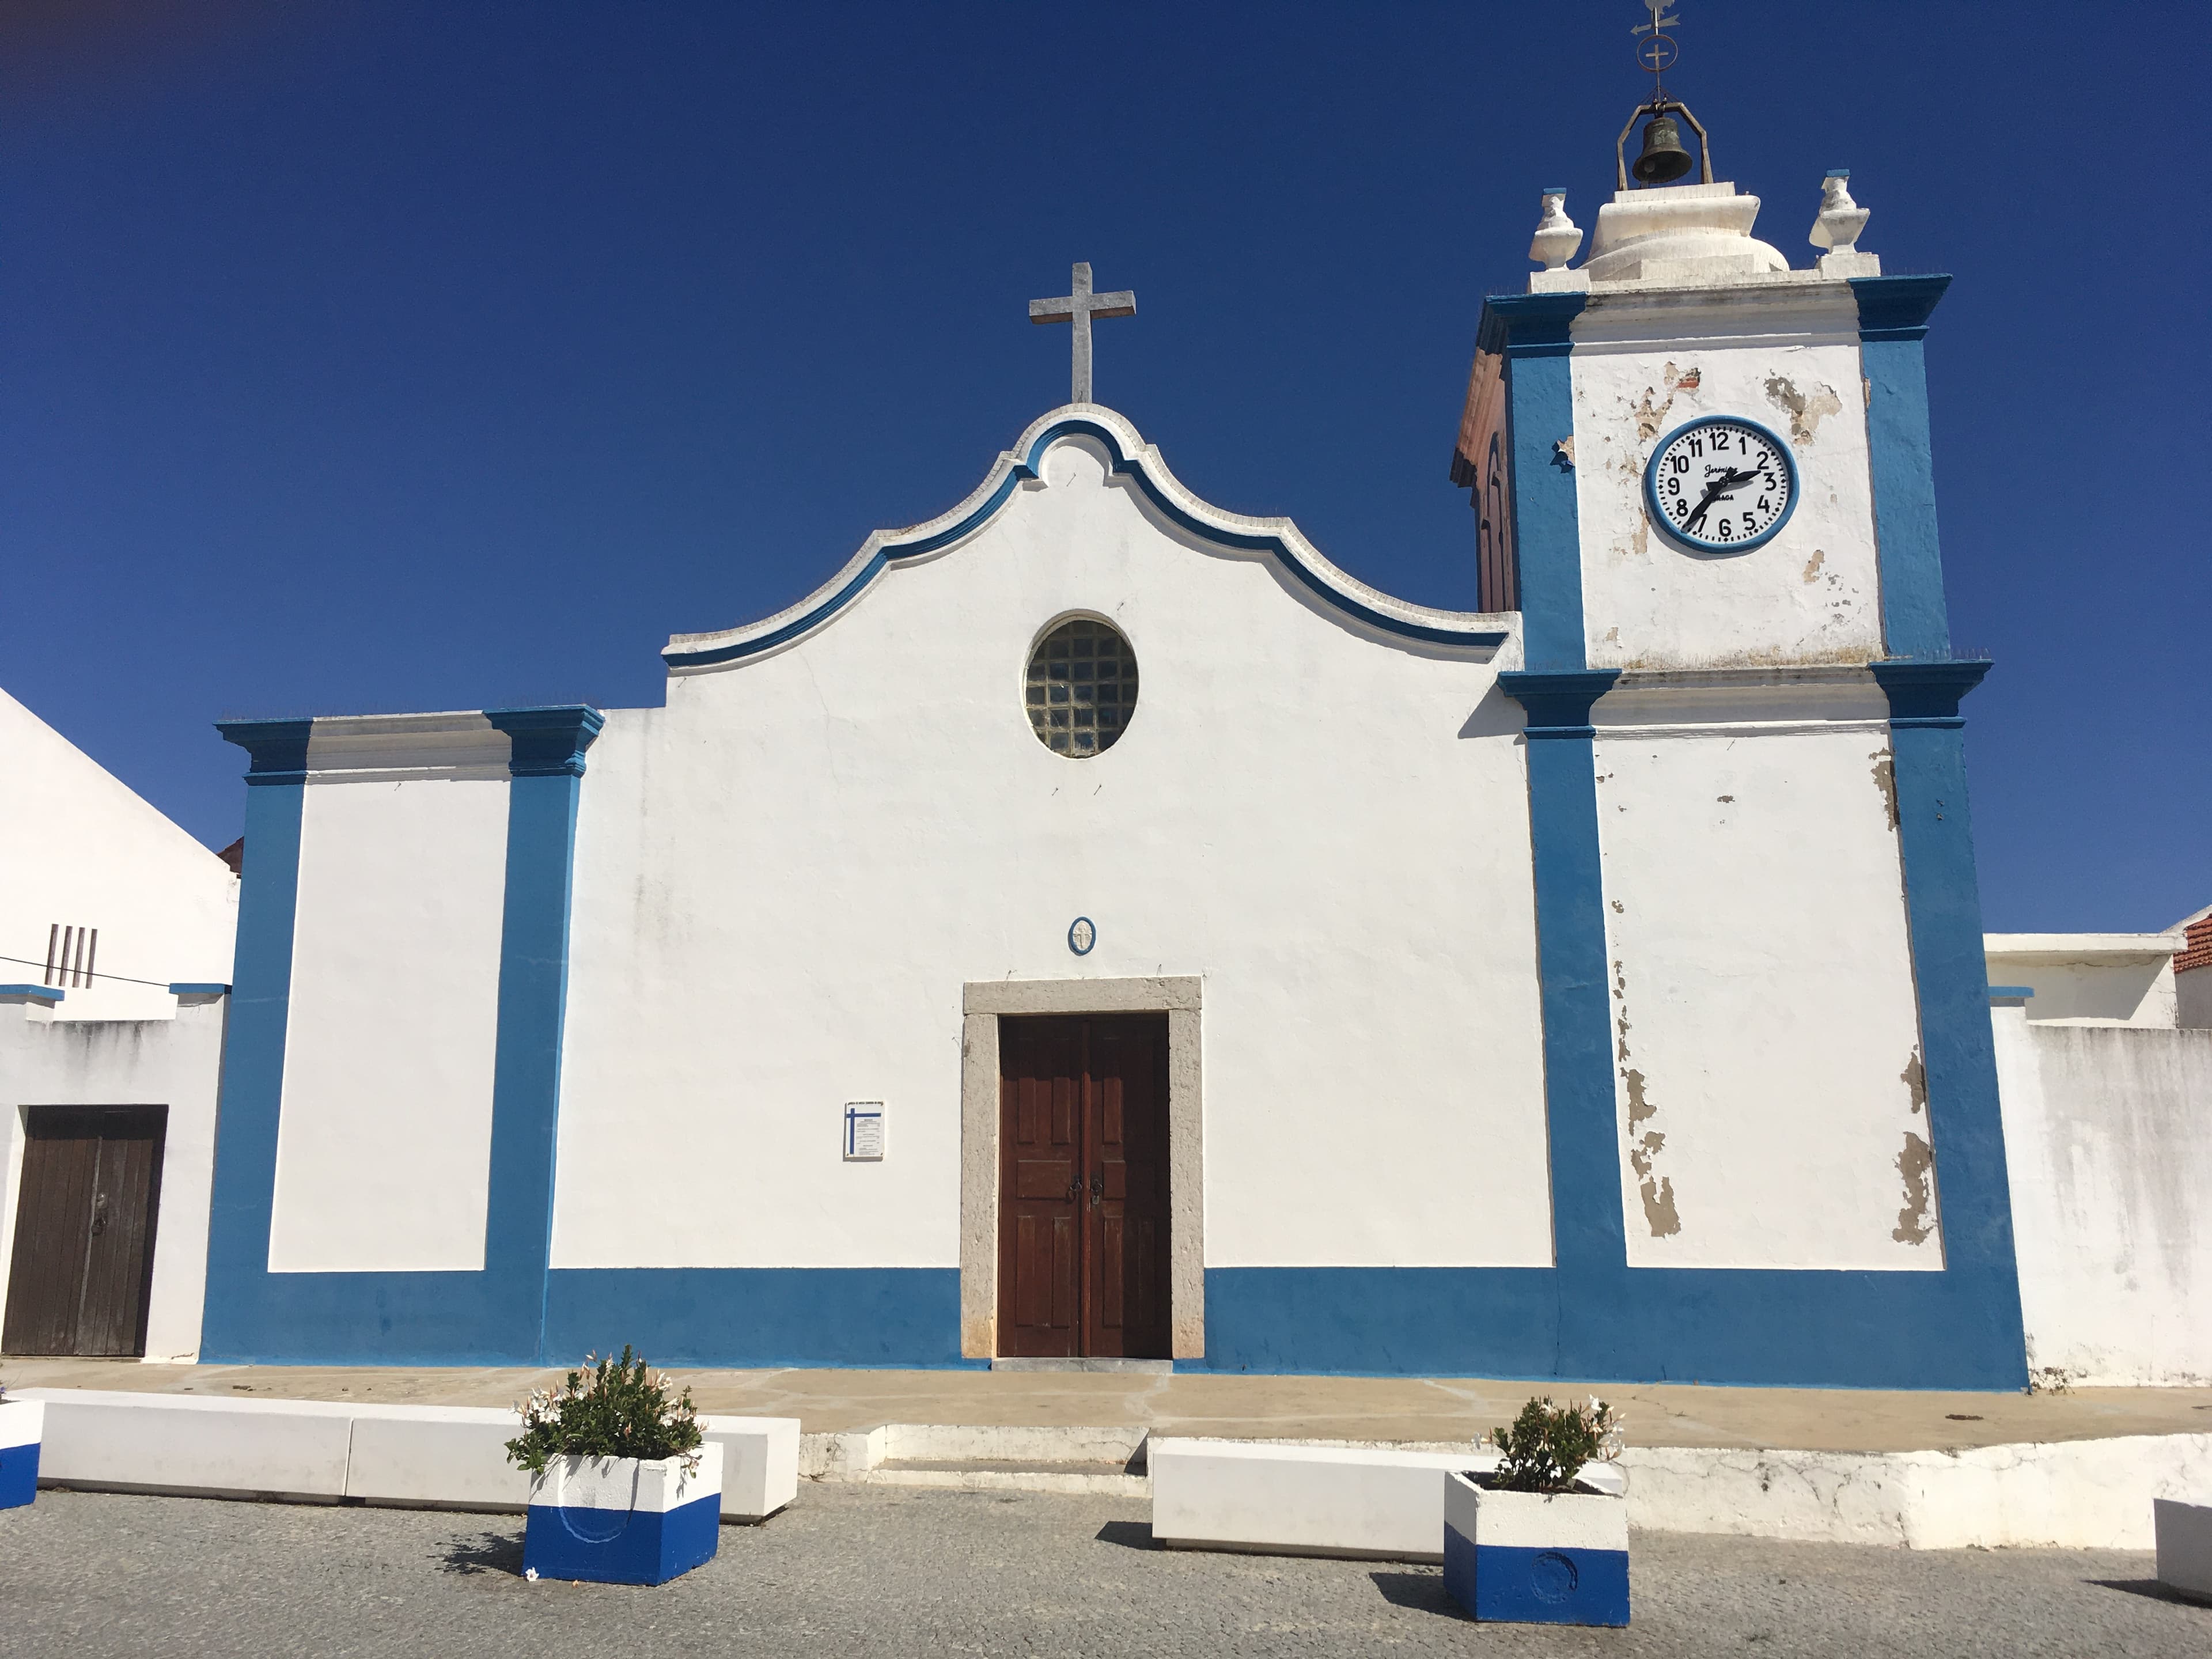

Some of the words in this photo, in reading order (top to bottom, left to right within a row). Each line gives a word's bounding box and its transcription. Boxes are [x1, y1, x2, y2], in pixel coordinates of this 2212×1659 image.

[1688, 439, 1702, 457] 11
[1709, 432, 1729, 450] 12
[1739, 437, 1746, 454] 1
[1671, 456, 1689, 474] 10
[1757, 451, 1770, 469] 2
[1668, 478, 1680, 495] 9
[1764, 472, 1777, 491] 3
[1676, 499, 1688, 517] 8
[1757, 495, 1770, 513] 4
[1697, 513, 1707, 533] 7
[1719, 518, 1732, 537] 6
[1743, 512, 1756, 531] 5
